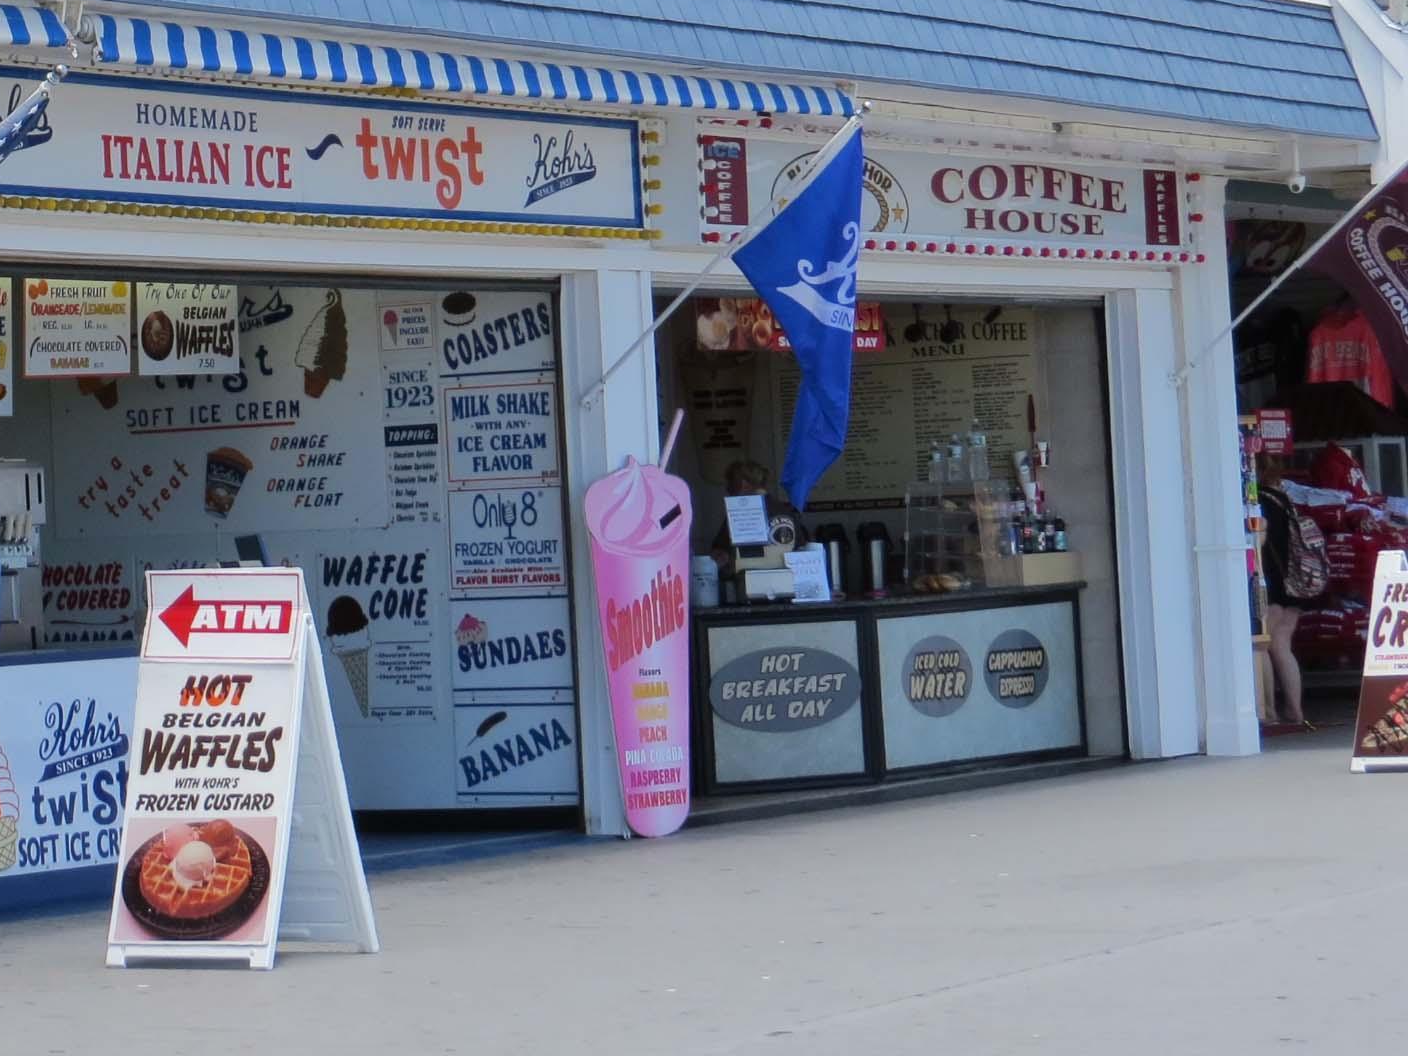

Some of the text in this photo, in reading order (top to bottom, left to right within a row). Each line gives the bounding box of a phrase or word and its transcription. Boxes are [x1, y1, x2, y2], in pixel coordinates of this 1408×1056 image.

[135, 103, 259, 133] HOMEMADE
[392, 116, 445, 133] SOFT SERVE
[102, 134, 292, 190] ITALIAN ICE
[356, 117, 484, 210] twist
[527, 129, 595, 187] Kohr's
[706, 143, 741, 159] ICE
[715, 161, 733, 224] COFFEE
[931, 164, 1127, 213] COFFEE
[1154, 171, 1169, 244] WAFFLES
[963, 207, 1104, 235] HOUSE
[1350, 227, 1384, 280] COFFEE
[50, 287, 107, 299] FRESH FRUIT
[143, 284, 231, 304] Try One Of Our
[183, 306, 227, 320] BELGIAN
[176, 320, 235, 360] WAFFLES
[443, 302, 551, 370] COASTERS
[856, 336, 879, 348] DAY
[972, 322, 1028, 342] COFFEE
[911, 344, 965, 358] MENU
[389, 369, 428, 384] SINCE
[385, 385, 434, 408] 1923
[451, 392, 551, 421] MILK SHAKE
[126, 400, 301, 428] SOFT ICE CREAM
[270, 434, 328, 451] ORANGE
[457, 433, 547, 453] ICE CREAM
[296, 452, 346, 468] SHAKE
[472, 455, 533, 473] FLAVOR
[78, 475, 109, 510] try
[105, 463, 154, 519] taste
[138, 458, 189, 522] treat
[266, 477, 328, 493] ORANGE
[294, 493, 344, 508] FLOAT
[473, 493, 518, 540] Only
[455, 540, 559, 557] FROZEN YOGURT
[42, 562, 123, 587] HOCOLATE
[323, 553, 427, 587] WAFFLE
[456, 574, 561, 585] FLAVOR BURST FLAVORS
[56, 587, 131, 612] COVERED
[369, 589, 428, 620] CONE
[191, 605, 282, 630] ATM
[606, 564, 684, 672] Smoothie
[458, 629, 566, 672] SUNDAES
[914, 652, 960, 670] ICED COLD
[988, 647, 1044, 671] CAPPUCINO
[761, 653, 805, 674] HOT
[179, 674, 253, 707] HOT
[722, 673, 847, 700] BREAKFAST
[910, 671, 968, 701] WATER
[162, 711, 266, 729] BELGIAN
[741, 698, 833, 723] ALL DAY
[39, 699, 123, 761] Kohr's
[638, 726, 667, 742] PEACH
[55, 748, 114, 776] SINCE 1923
[139, 726, 283, 776] WAFFLES
[459, 718, 572, 788] BANANA
[174, 776, 240, 789] WITH KOHR'S
[630, 769, 681, 789] RASPBERRY
[135, 793, 274, 812] FROZEN CUSTARD
[627, 788, 687, 810] STRAWBERRY
[18, 833, 59, 867] SOFT
[64, 831, 91, 861] ICE
